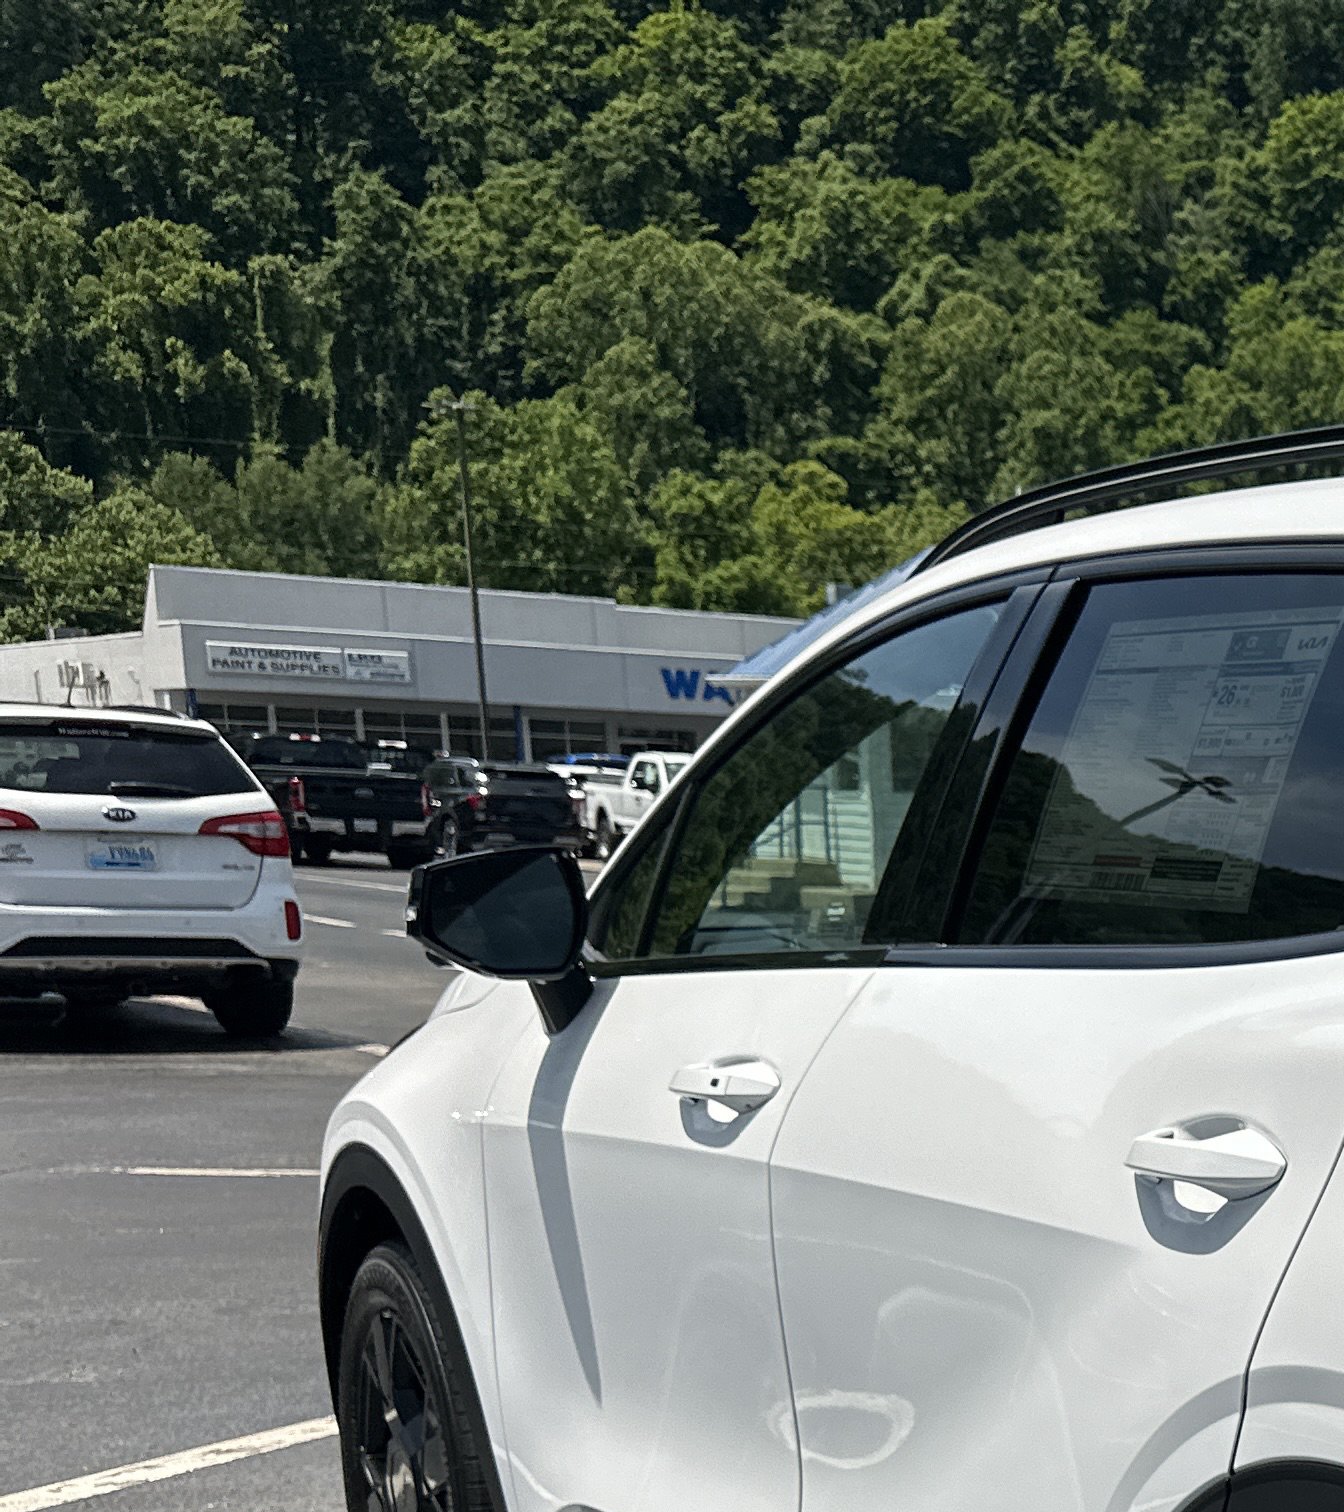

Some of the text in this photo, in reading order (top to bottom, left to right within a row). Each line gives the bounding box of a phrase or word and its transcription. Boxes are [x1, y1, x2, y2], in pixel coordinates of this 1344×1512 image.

[228, 647, 321, 662] AUTOMOTIVE
[211, 658, 253, 670] PAINT
[270, 661, 341, 674] SUPPLIES
